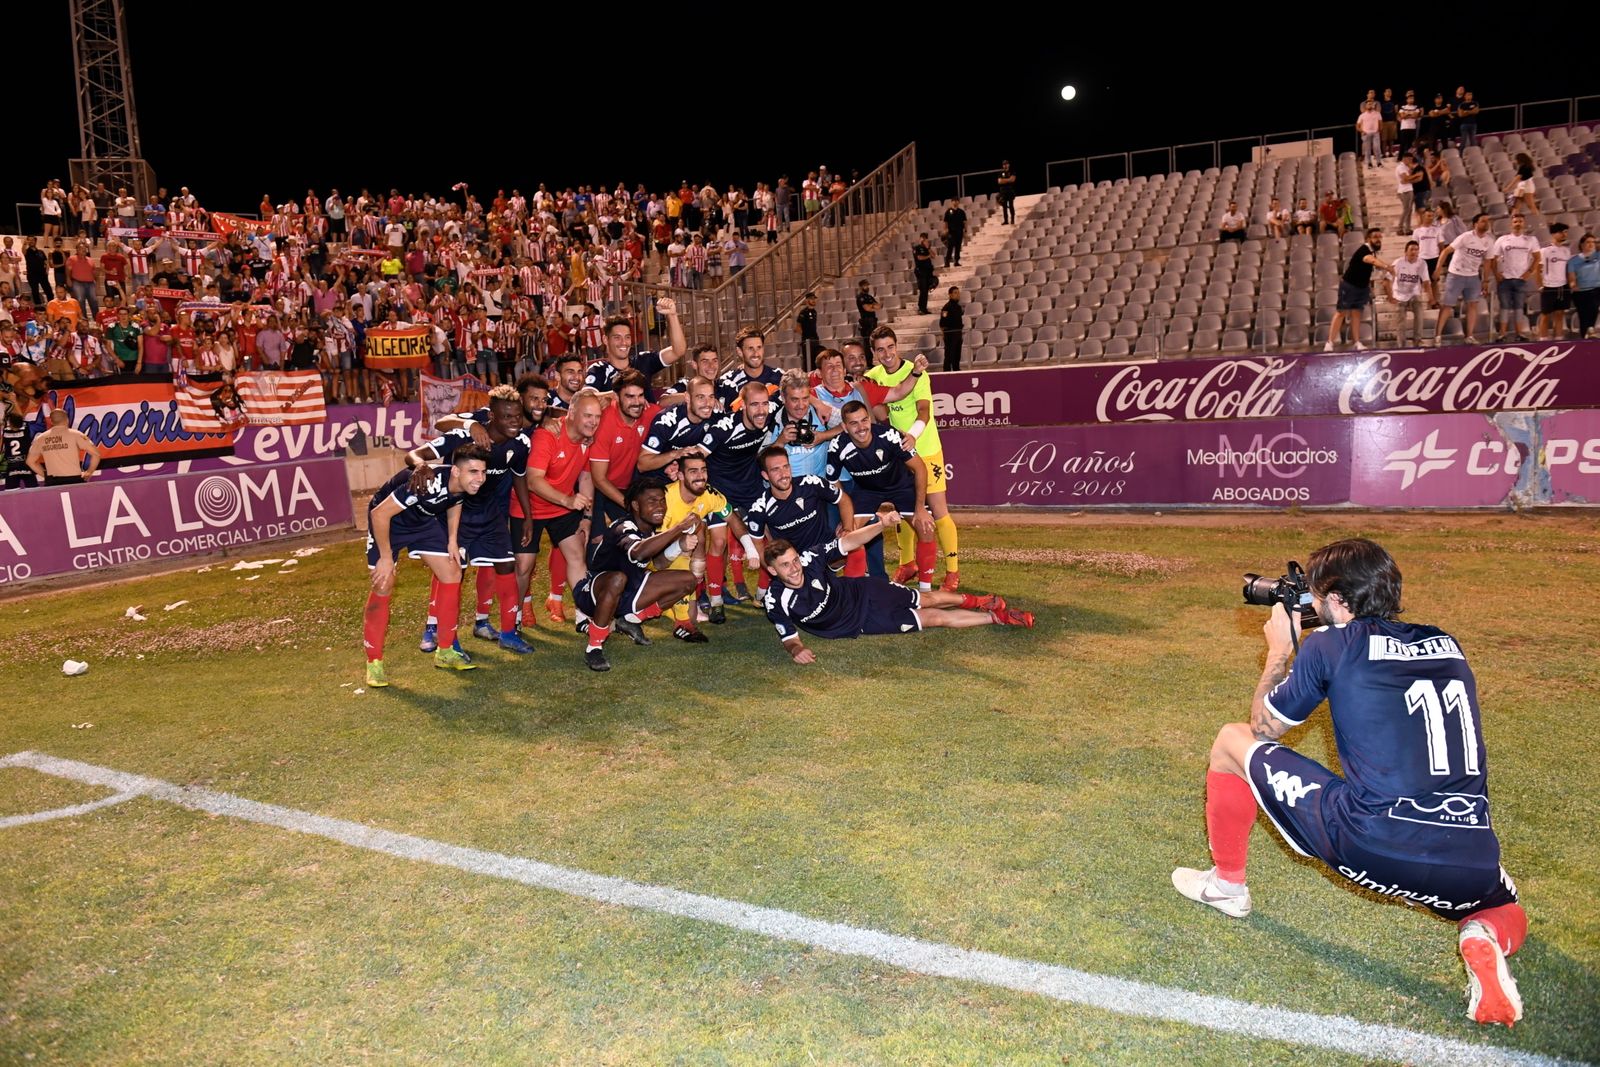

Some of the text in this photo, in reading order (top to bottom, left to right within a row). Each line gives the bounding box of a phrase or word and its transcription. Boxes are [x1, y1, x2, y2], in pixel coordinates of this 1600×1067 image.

[366, 335, 432, 356] ALGECIRAS
[1096, 357, 1300, 422] Coca-Cola
[1338, 345, 1575, 414] Coca-Cola
[932, 377, 1011, 417] aén
[949, 417, 960, 427] de
[962, 416, 986, 426] fútbol
[10, 440, 21, 456] 2
[1000, 440, 1136, 474] 40 años
[1187, 447, 1338, 465] MedinaCuadros
[1007, 480, 1056, 497] 1978
[1071, 480, 1127, 496] 2018
[1212, 487, 1311, 501] ABOGADOS
[60, 486, 152, 549] LA
[168, 466, 325, 533] LOMA
[73, 516, 328, 570] CENTRO COMERCIAL Y DE OCIO
[1404, 679, 1481, 776] 11
